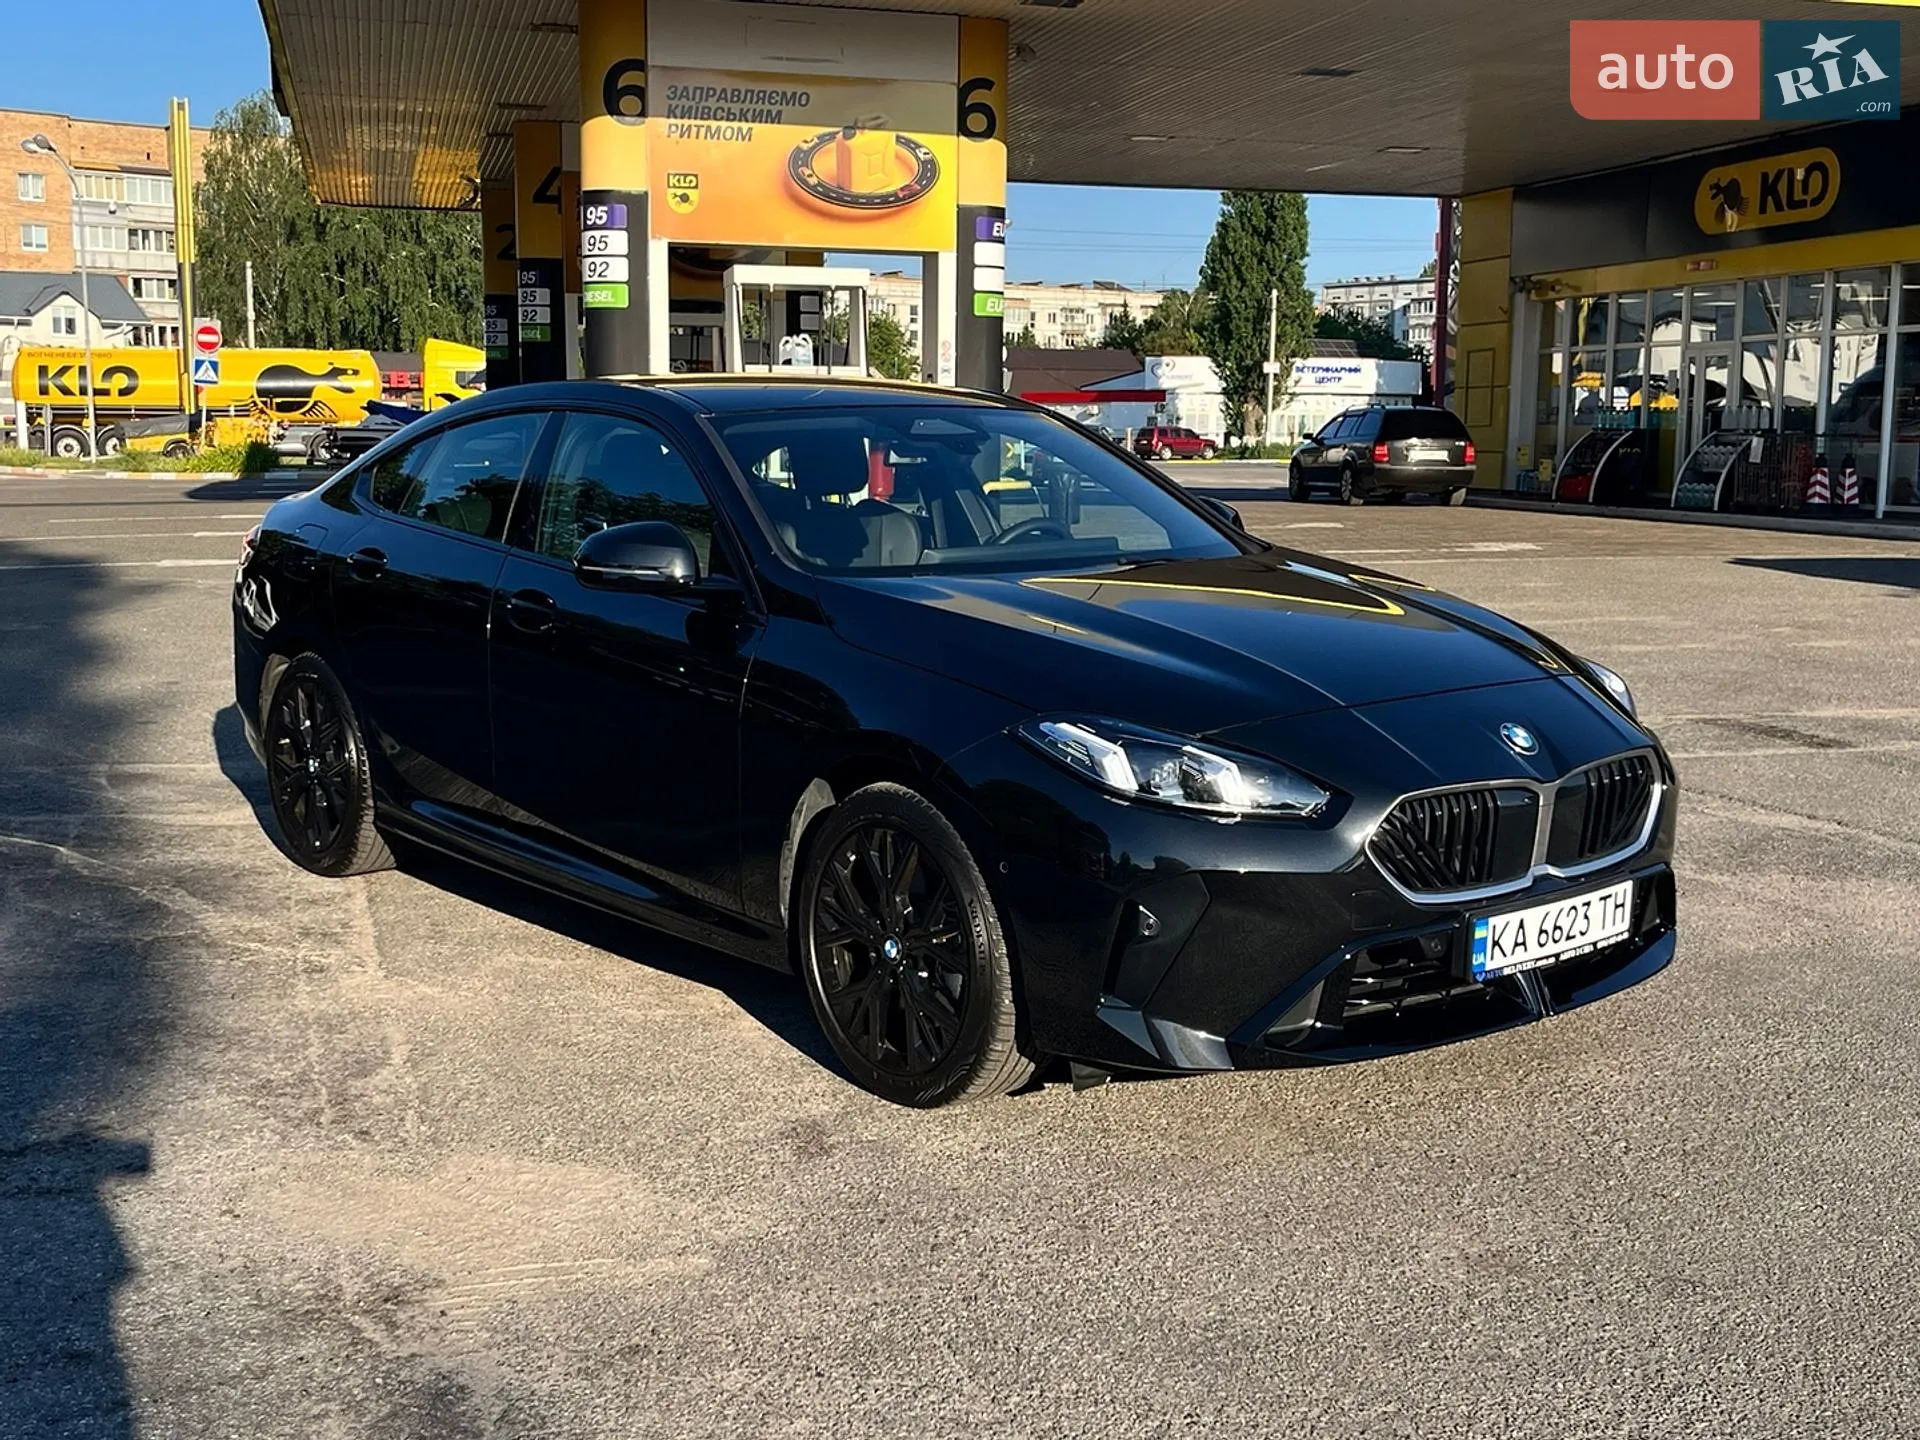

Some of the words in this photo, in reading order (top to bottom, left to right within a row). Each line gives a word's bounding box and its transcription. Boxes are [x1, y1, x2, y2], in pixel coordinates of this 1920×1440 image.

[603, 58, 645, 126] 6
[666, 84, 811, 108] ЗАПРАВЛЯЄМО
[666, 103, 783, 125] КИЇВСЬКИМ
[958, 77, 996, 142] 6
[666, 123, 754, 142] РИТМОМ
[669, 174, 697, 188] KLO
[1758, 161, 1830, 215] KLO
[586, 205, 609, 226] 95
[587, 234, 609, 252] 95
[521, 271, 536, 285] 95
[587, 260, 610, 279] 92
[521, 290, 537, 303] 95
[522, 309, 538, 322] 92
[37, 364, 140, 397] KLO
[1315, 376, 1342, 384] ЦЕНТР
[1490, 917, 1528, 961] KA
[1537, 900, 1591, 948] 6623
[1599, 888, 1627, 931] TH
[1473, 952, 1485, 966] UA
